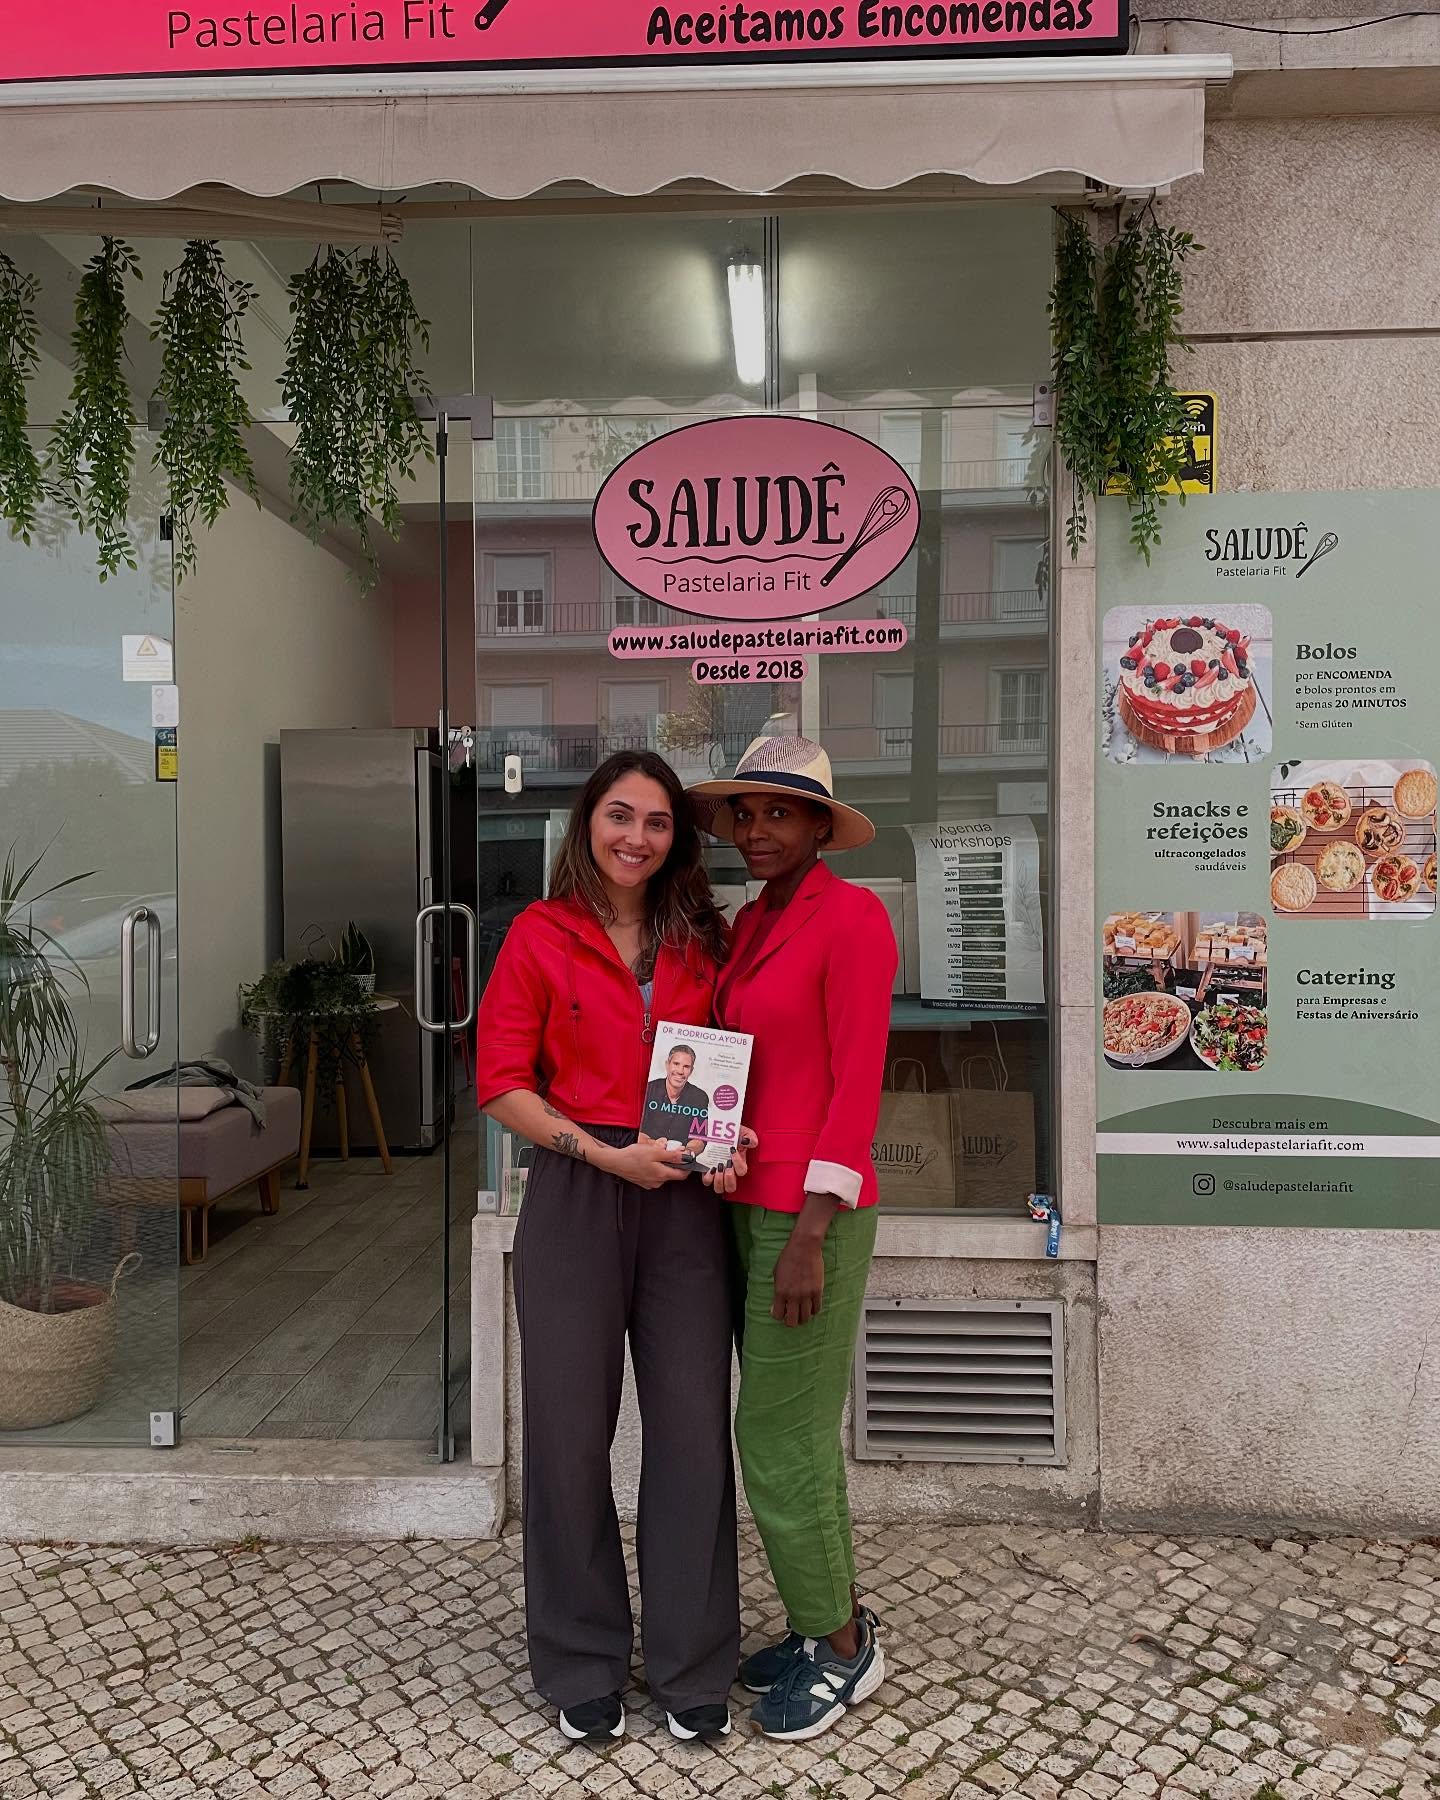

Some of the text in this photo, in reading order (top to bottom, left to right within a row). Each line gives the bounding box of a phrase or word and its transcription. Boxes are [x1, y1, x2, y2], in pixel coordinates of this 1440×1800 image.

[168, 0, 456, 48] Pastelaria Fit
[646, 0, 1093, 46] Aceitamos Encomendas
[626, 462, 846, 548] SALUDÊ
[1205, 522, 1308, 561] SALUDÊ
[1216, 566, 1286, 576] Pastelaria Fit
[664, 571, 812, 594] Pastelaria Fit
[612, 626, 904, 654] www.saludepastelariafit.com
[1296, 643, 1357, 660] Bolos
[696, 660, 804, 681] Desde 2018
[1296, 670, 1392, 682] por ENCOMENDA
[1304, 685, 1332, 694] bolos
[1335, 686, 1377, 696] prontos
[1296, 699, 1407, 711] apenas 20 MINUTOS
[1321, 720, 1353, 728] Glúten
[1153, 800, 1248, 818] Snacks e
[939, 823, 992, 835] Agenda
[1146, 822, 1248, 843] refeições
[930, 836, 1012, 848] Workshops
[1154, 849, 1246, 860] ultracongelados
[1194, 861, 1247, 871] saudáveis
[1296, 968, 1395, 990] Catering
[1296, 997, 1320, 1007] para
[1323, 996, 1378, 1007] Empresas
[1296, 1010, 1419, 1020] Festas de Aniversário
[677, 1028, 717, 1041] RODRIGO
[718, 1035, 748, 1046] AYOUB
[649, 1101, 658, 1110] O
[690, 1117, 736, 1139] MES
[1212, 1118, 1328, 1130] Descubra mais em
[870, 1142, 923, 1164] SALUDÊ
[1176, 1139, 1364, 1152] www.saludepastelariafit.com
[1223, 1179, 1353, 1194] @saludepastelariafit
